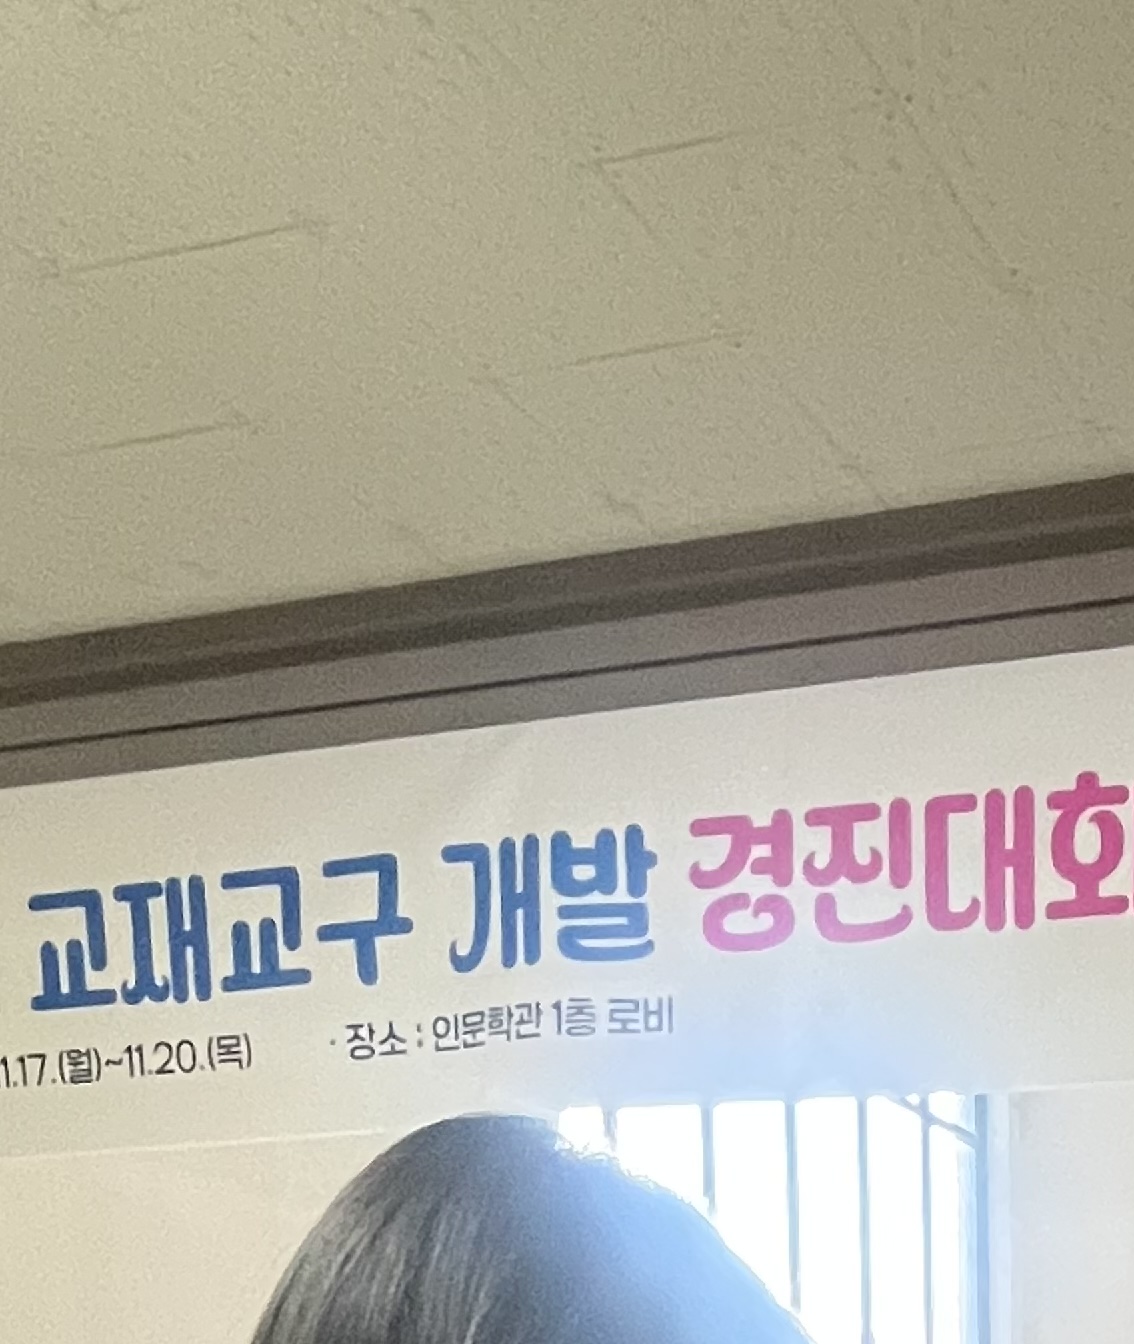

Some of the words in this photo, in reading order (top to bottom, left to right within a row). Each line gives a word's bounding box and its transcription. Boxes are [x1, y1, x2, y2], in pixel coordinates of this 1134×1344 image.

[28, 853, 414, 1011] 교재교구
[441, 823, 658, 973] 개발
[345, 1021, 408, 1060] 장소
[432, 1001, 544, 1052] 인문학관
[550, 997, 597, 1037] 1층
[607, 994, 674, 1035] 로비
